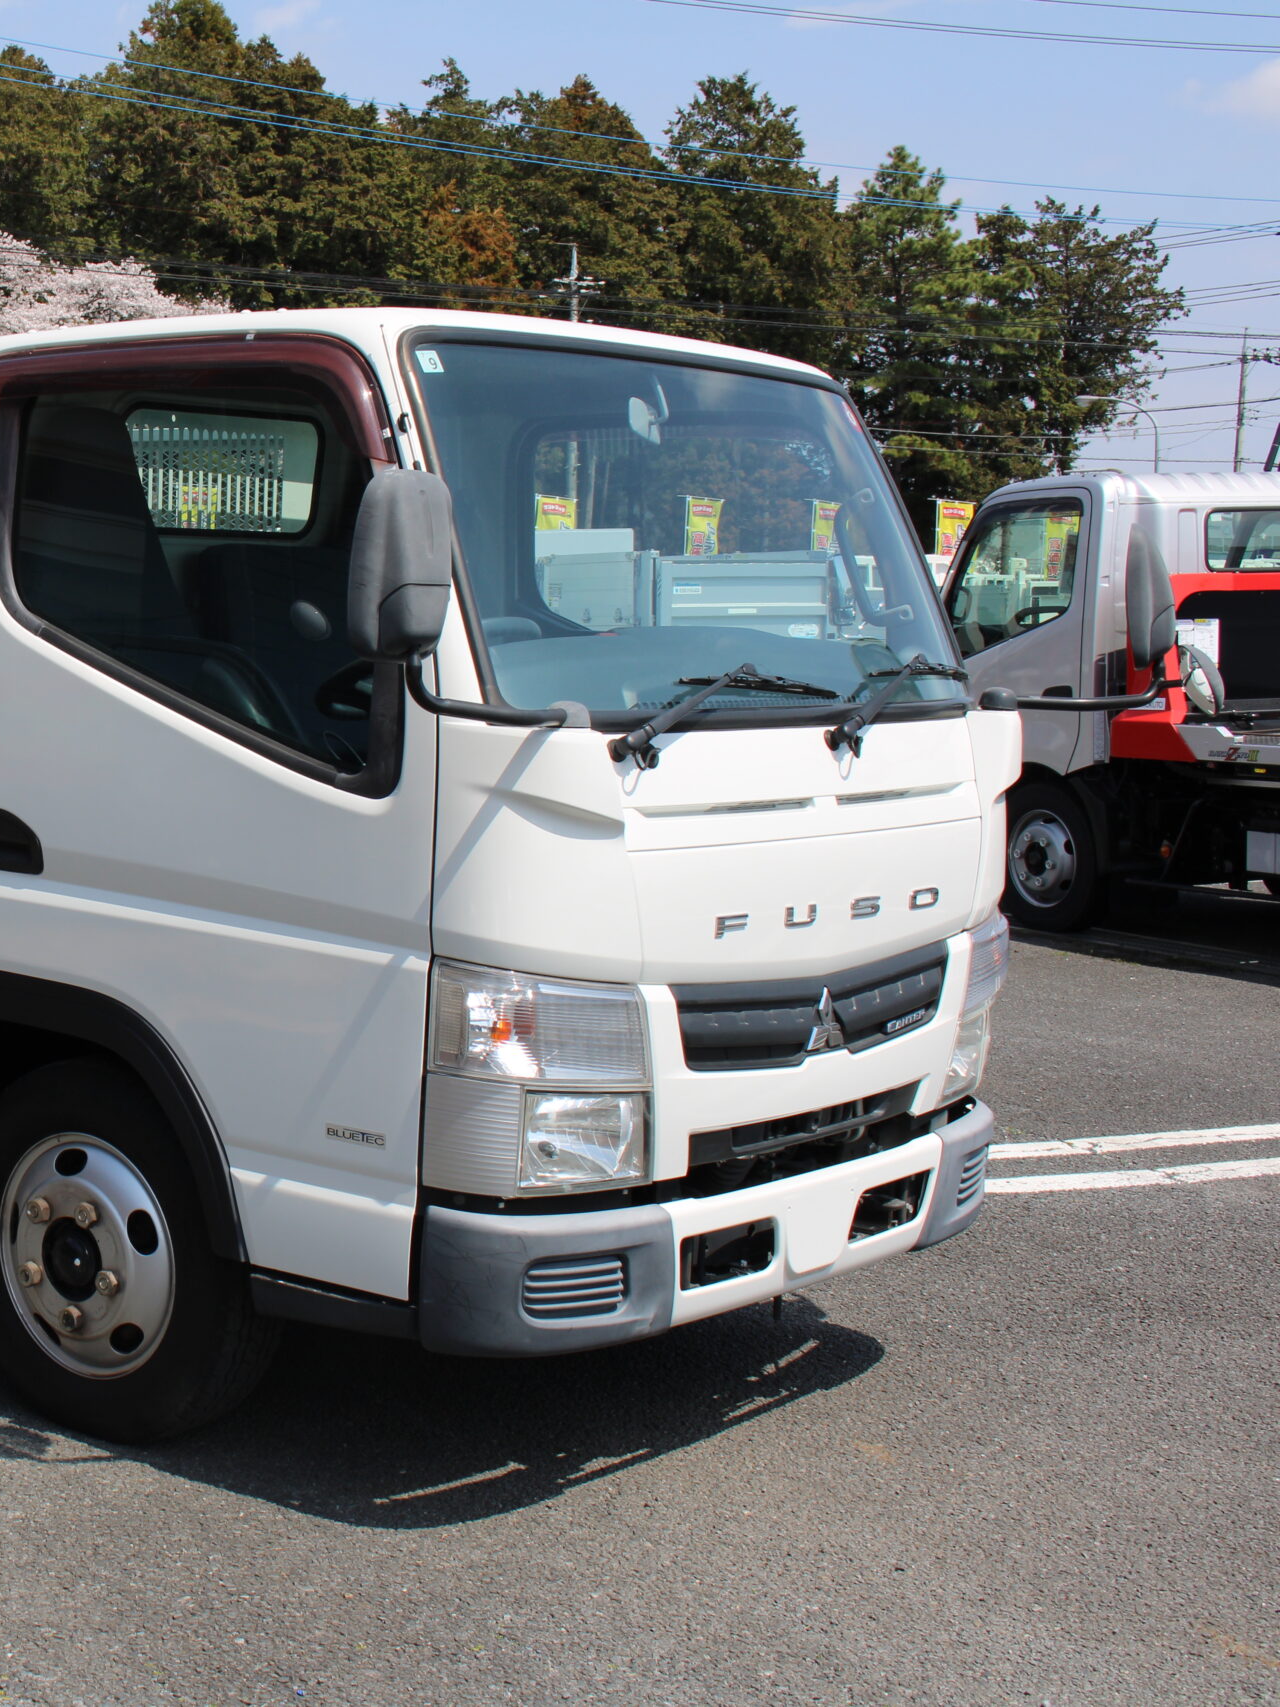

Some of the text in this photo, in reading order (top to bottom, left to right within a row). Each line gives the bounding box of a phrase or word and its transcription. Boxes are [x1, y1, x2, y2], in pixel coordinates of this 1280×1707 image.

[428, 357, 438, 370] 9
[714, 887, 940, 940] FUSO
[326, 1127, 385, 1146] BLUETEC
